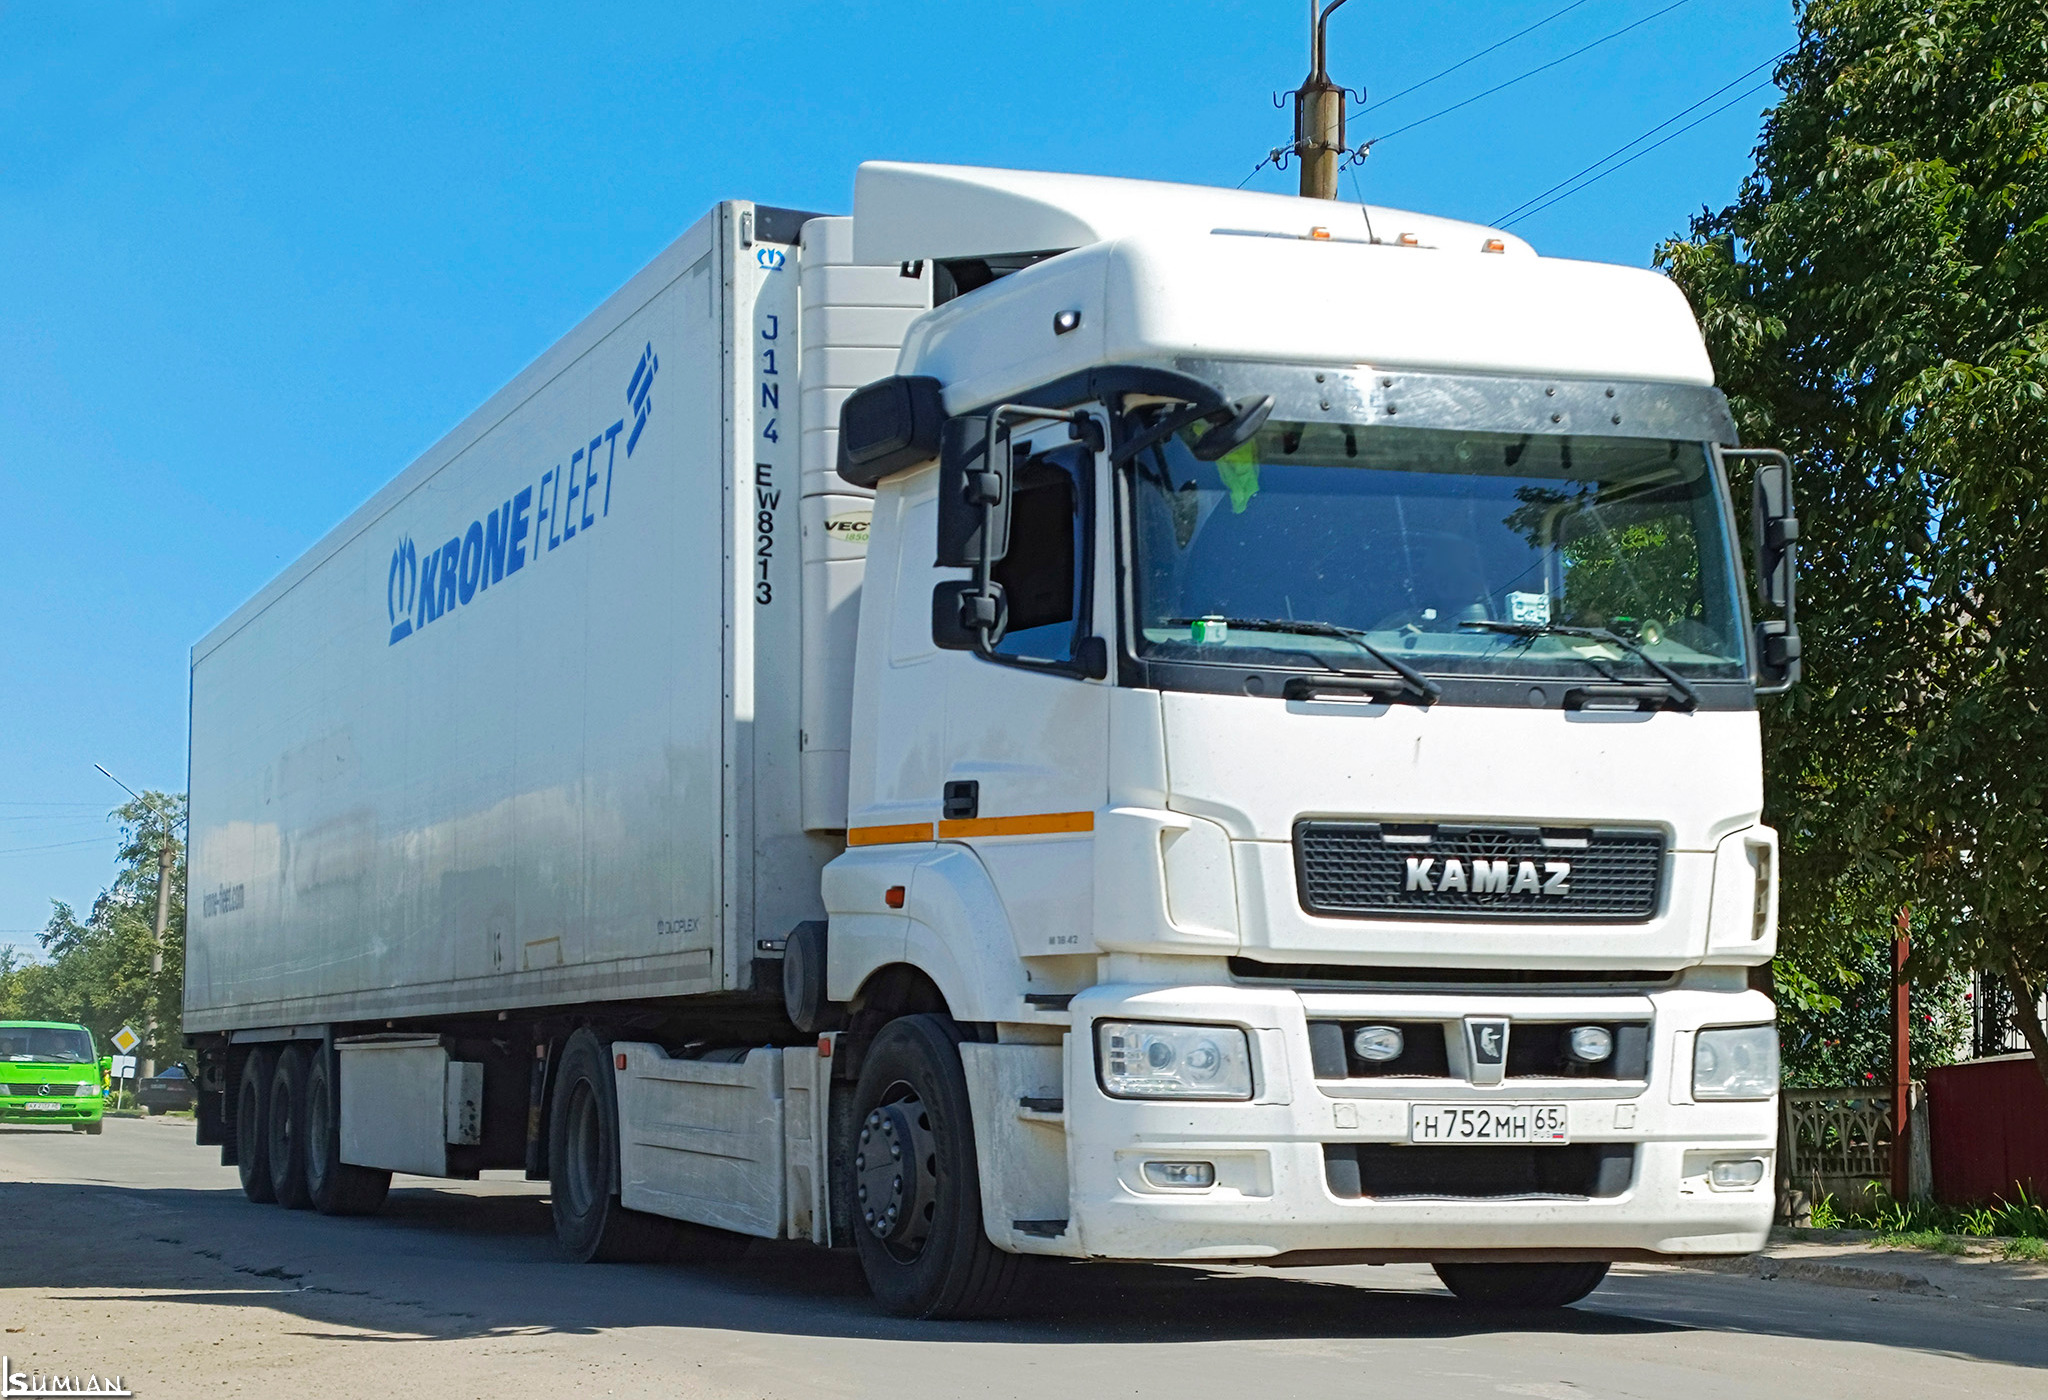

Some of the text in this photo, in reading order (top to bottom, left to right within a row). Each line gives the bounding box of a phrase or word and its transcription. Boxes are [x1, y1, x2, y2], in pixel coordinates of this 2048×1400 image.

[416, 418, 624, 631] KRONE FLEET
[823, 520, 871, 531] VEC
[1405, 857, 1571, 896] KAMAZ
[1535, 1108, 1558, 1130] 65
